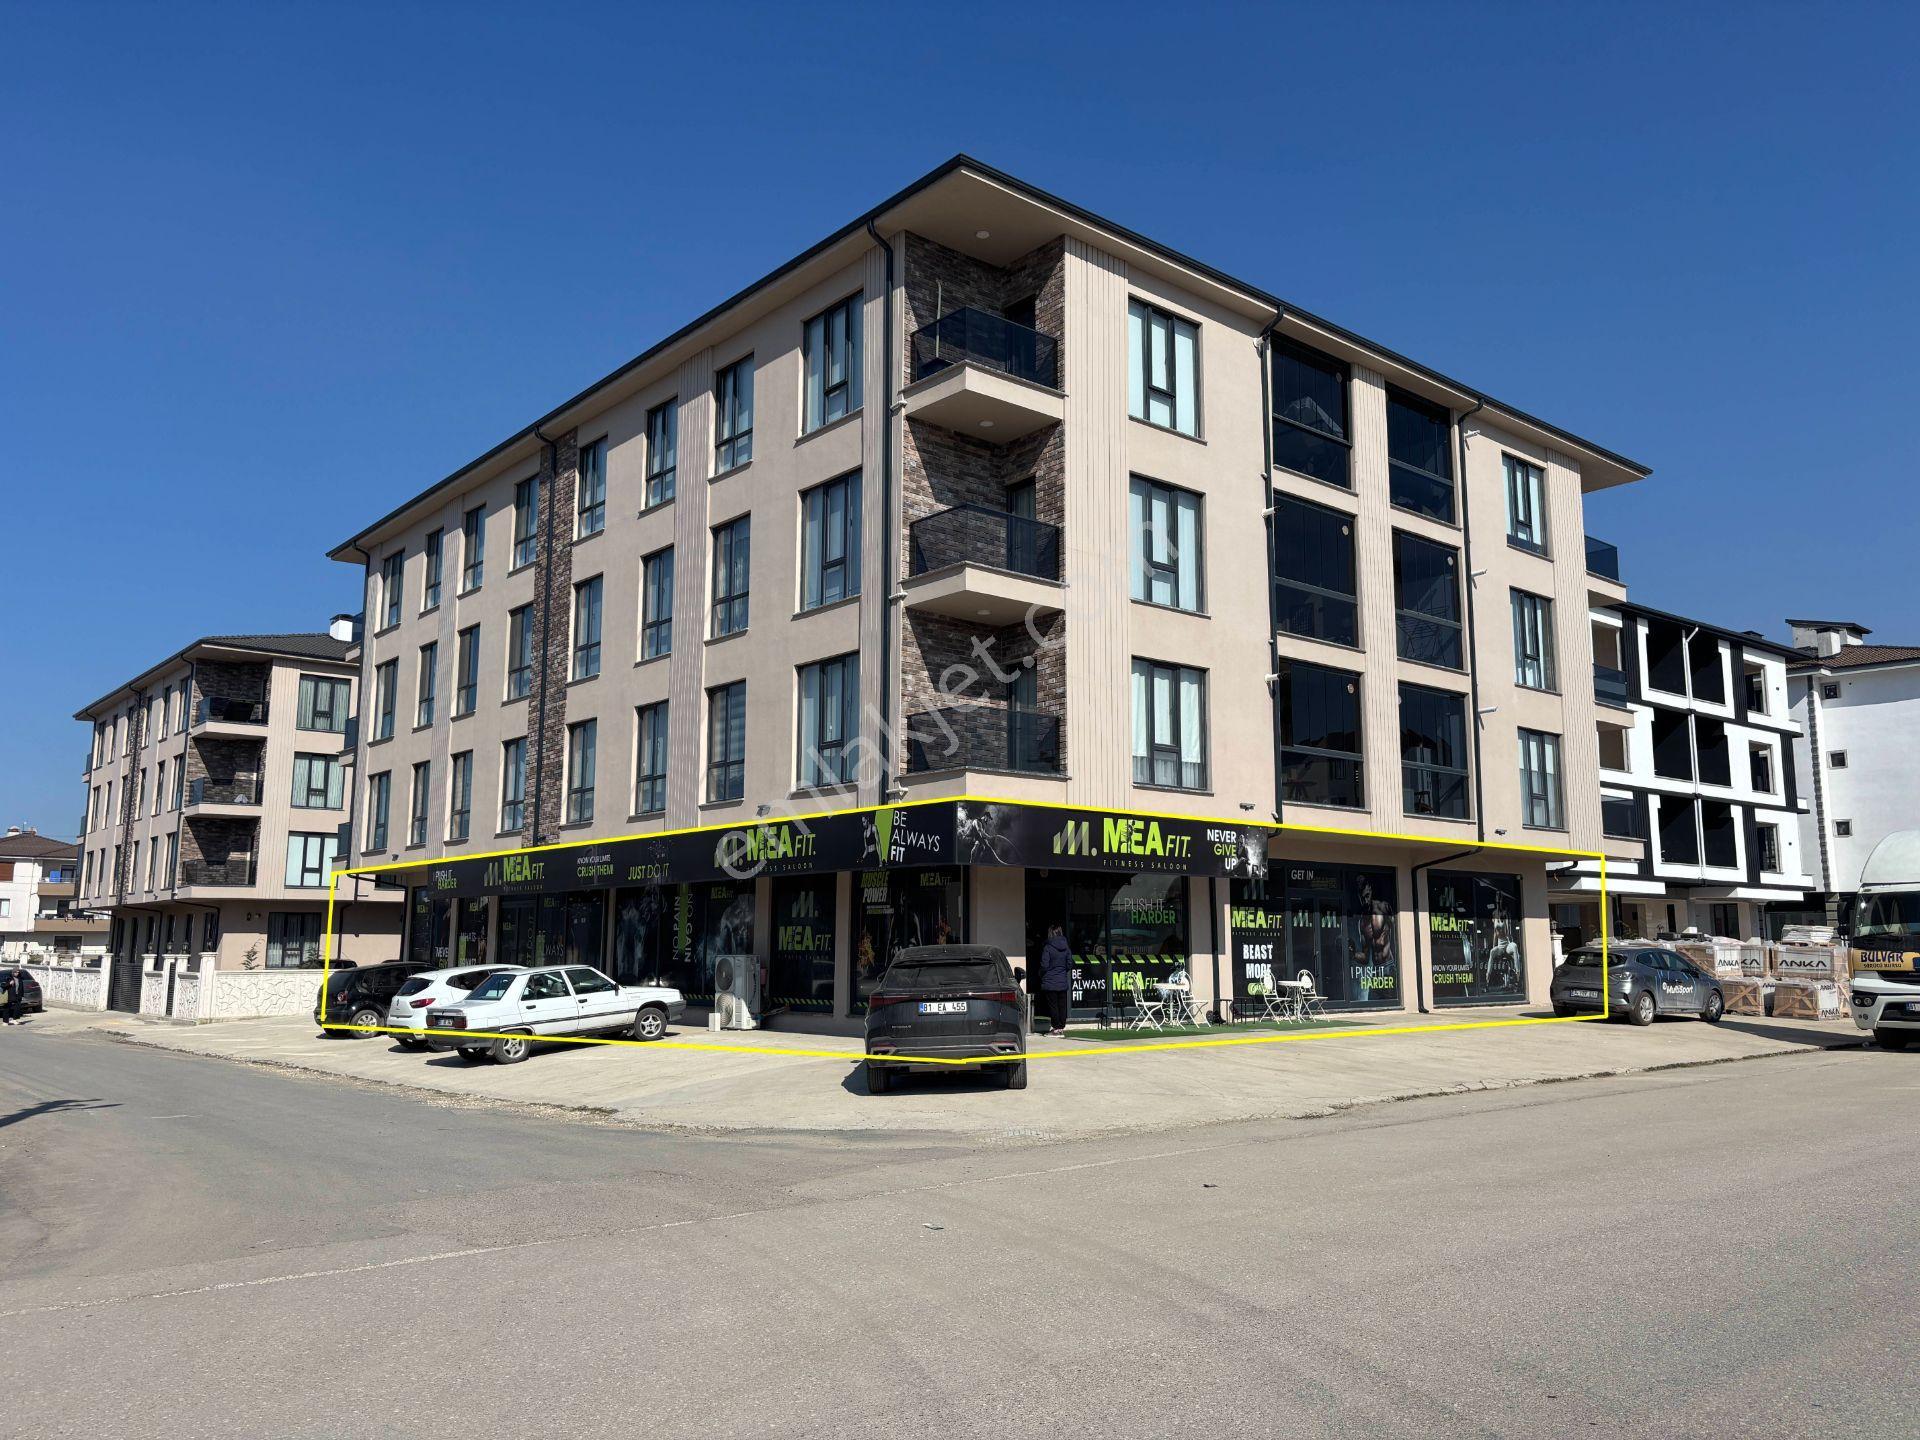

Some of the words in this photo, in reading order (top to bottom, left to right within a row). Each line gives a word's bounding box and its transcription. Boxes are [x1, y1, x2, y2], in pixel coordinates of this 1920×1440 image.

[893, 810, 908, 827] BE
[891, 829, 941, 852] ALWAYS
[1206, 828, 1237, 844] NEVER
[890, 845, 906, 863] FIT
[1213, 843, 1237, 857] GIVE
[1103, 859, 1144, 868] FITNESS
[1151, 861, 1187, 871] SALOON
[1224, 857, 1238, 870] UP
[628, 865, 646, 880] JUST
[647, 863, 660, 878] DO
[662, 863, 669, 877] IT
[1290, 869, 1305, 880] GET
[1131, 910, 1176, 925] HARDER
[1242, 944, 1273, 960] BEAST
[1861, 951, 1904, 963] BULVAR
[1718, 959, 1740, 967] ANKA
[1779, 960, 1827, 968] ANKA
[1071, 969, 1083, 980] BE
[1355, 967, 1377, 978] PUSH
[1378, 966, 1385, 978] IT
[1071, 979, 1106, 990] ALWAYS
[1360, 977, 1394, 989] HARDER
[1433, 973, 1455, 984] CRUSH
[1072, 991, 1083, 1001] FIT
[938, 1003, 947, 1012] EA
[952, 1002, 966, 1011] 455
